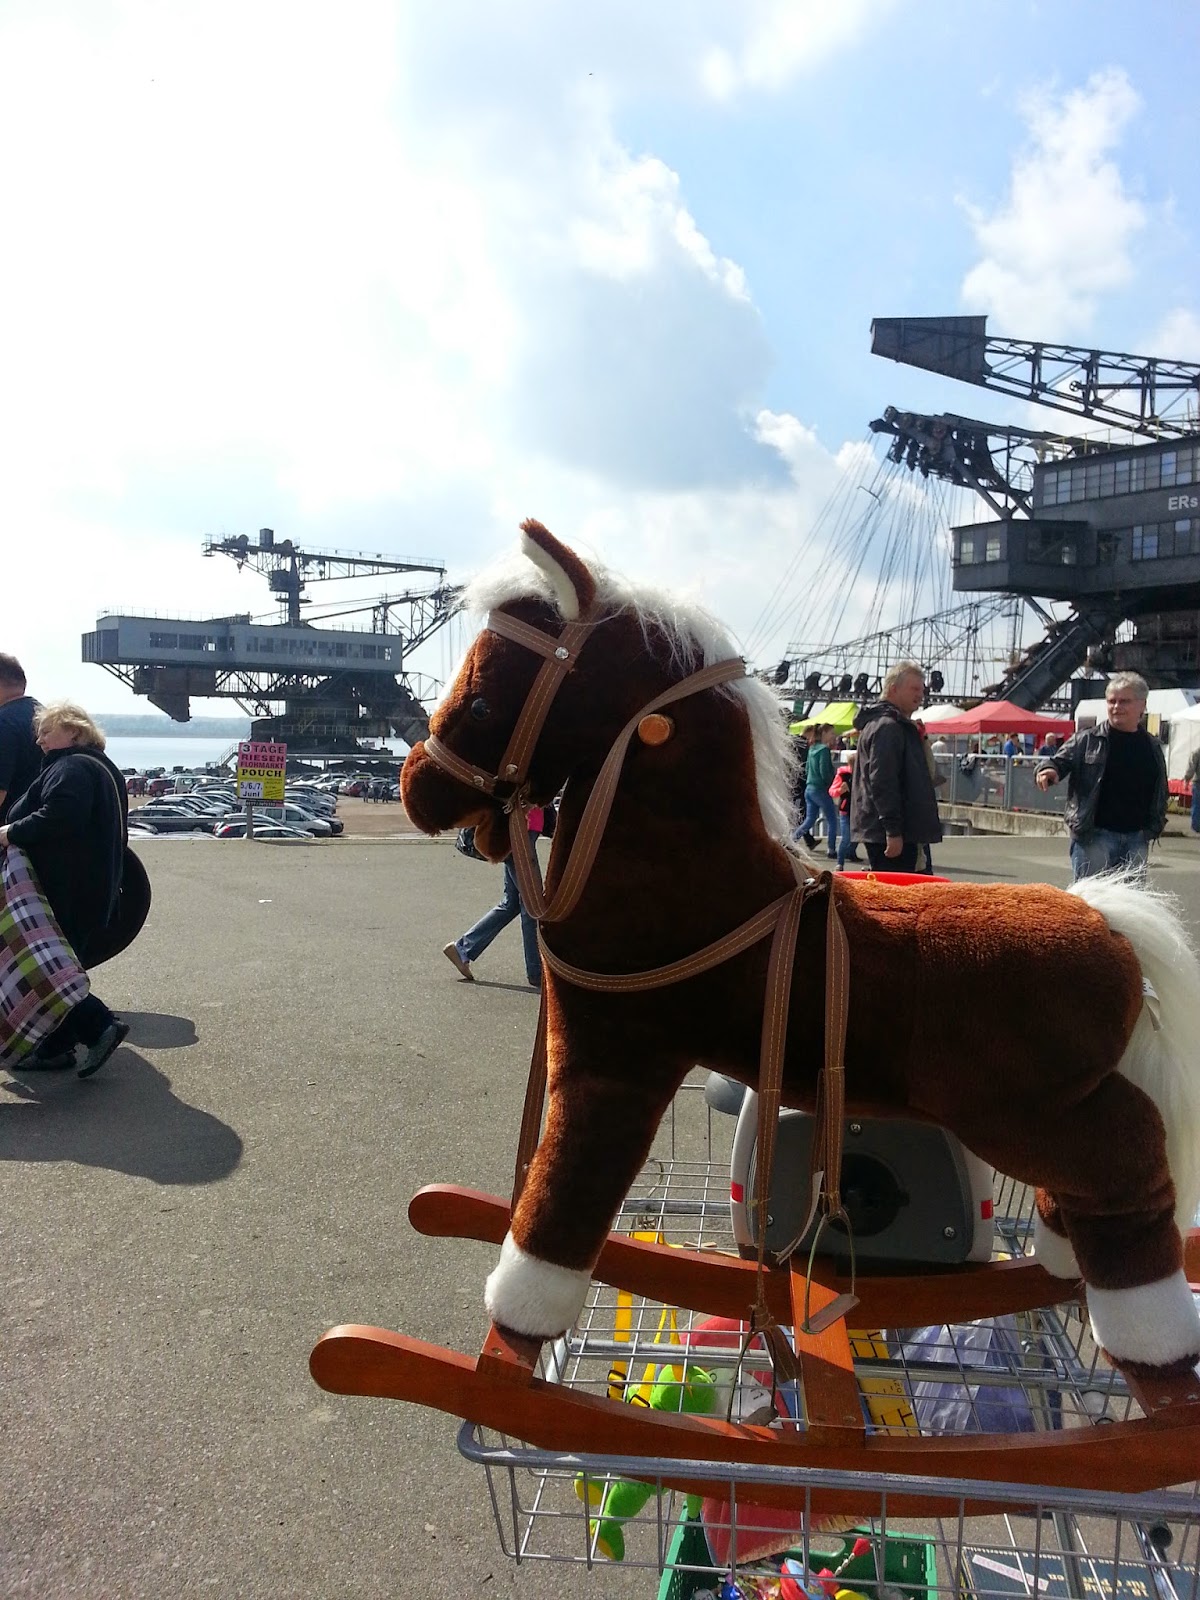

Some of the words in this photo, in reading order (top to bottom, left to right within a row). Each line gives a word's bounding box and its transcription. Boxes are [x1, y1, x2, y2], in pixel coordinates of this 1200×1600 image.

[1168, 495, 1199, 511] ERs
[243, 744, 251, 752] 3
[254, 745, 285, 754] TAGE
[242, 754, 284, 762] RIESEN
[241, 761, 283, 769] FLOHMARKT
[242, 769, 281, 777] POUCH
